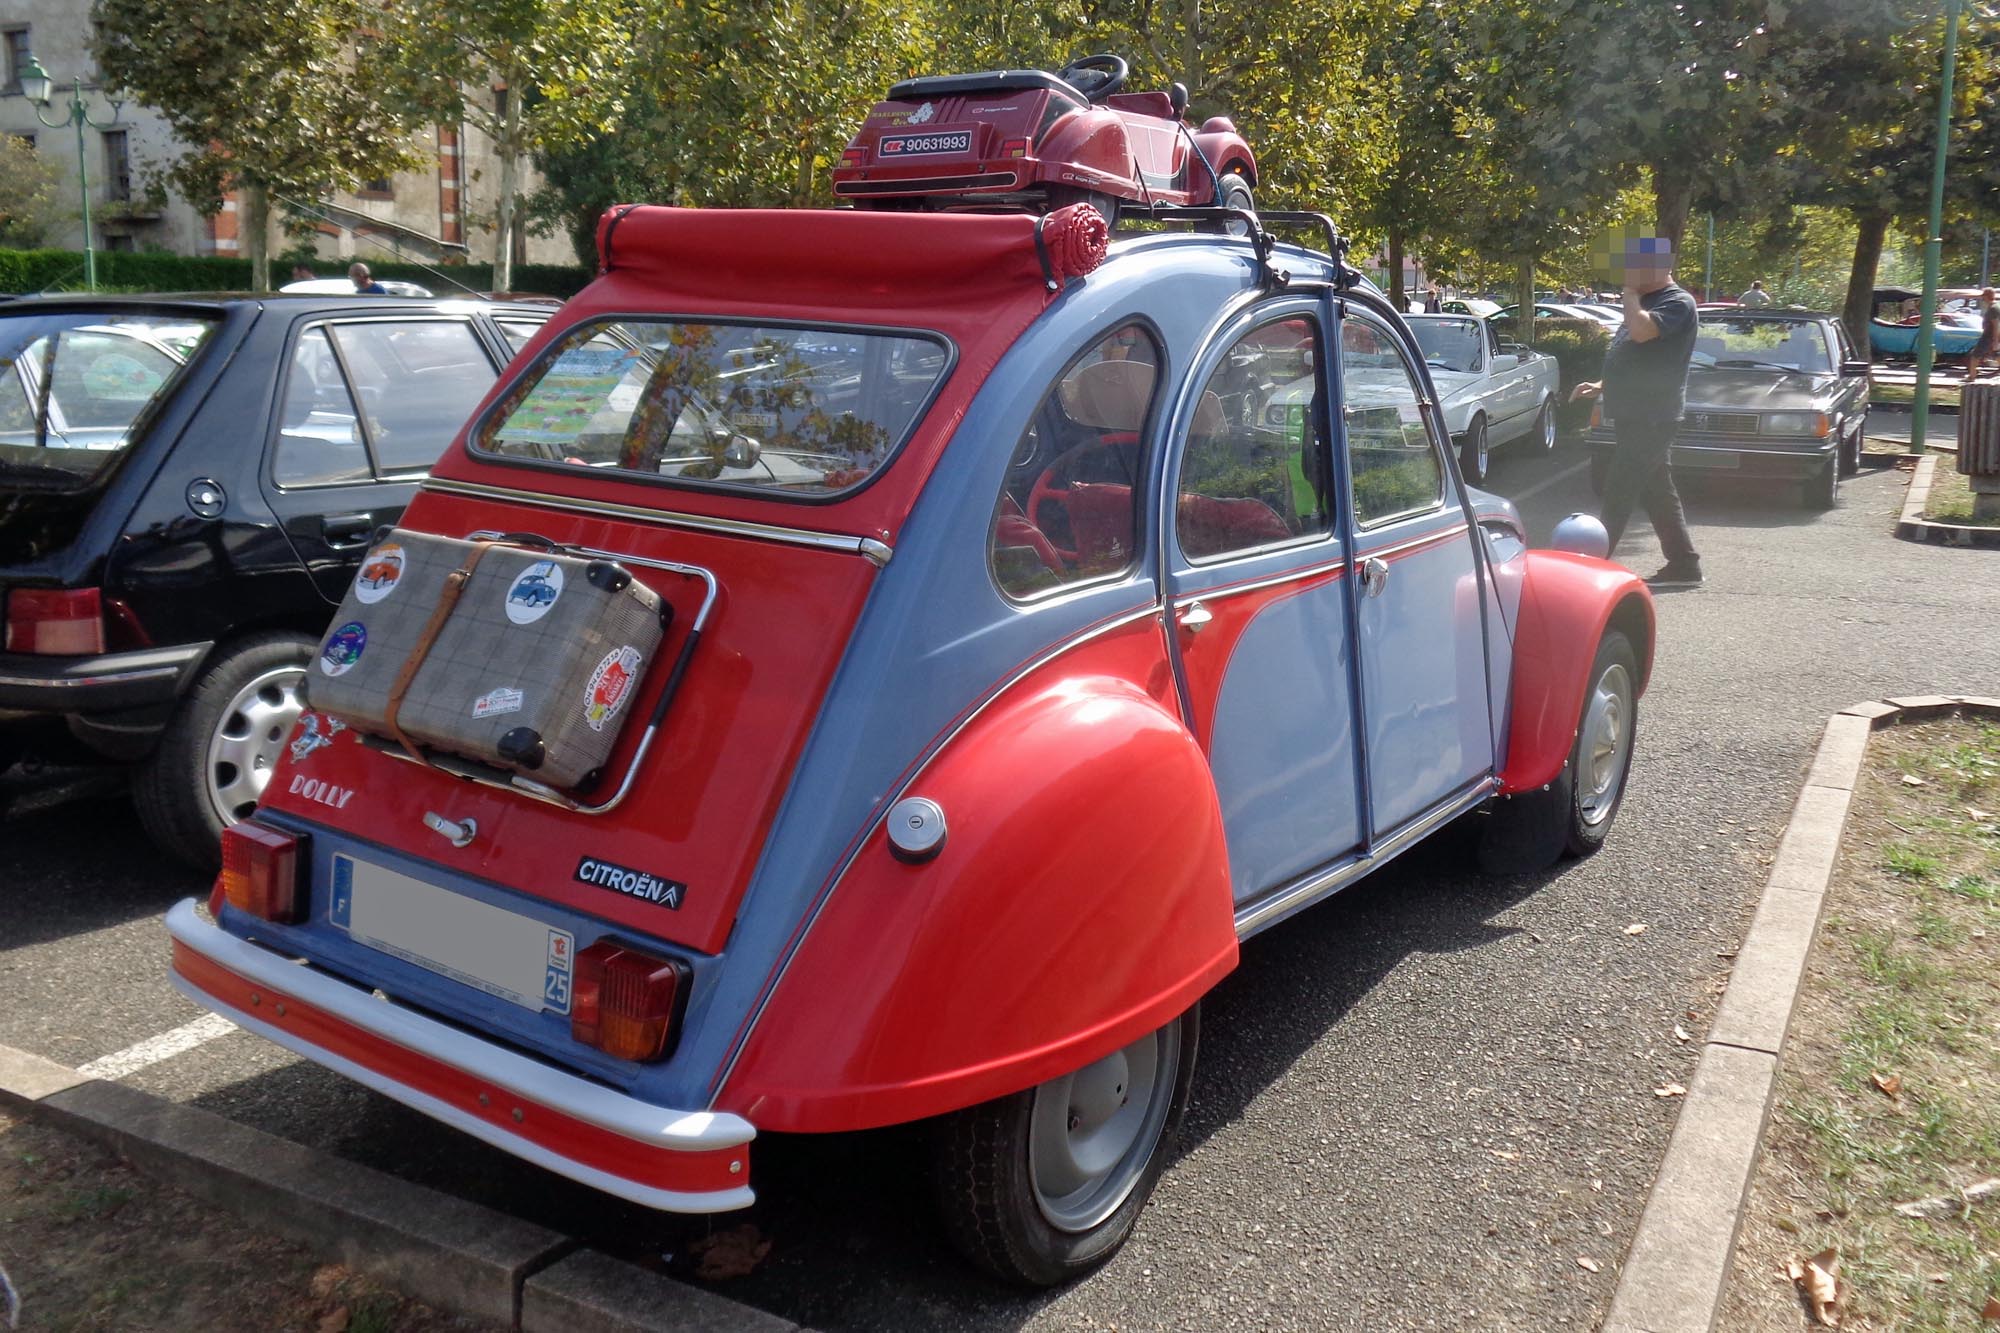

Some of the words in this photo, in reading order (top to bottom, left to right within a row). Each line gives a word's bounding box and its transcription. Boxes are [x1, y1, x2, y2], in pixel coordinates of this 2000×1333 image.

[906, 136, 967, 152] 90631993
[288, 774, 355, 809] DOLLY
[579, 861, 664, 901] CITROËN
[337, 898, 345, 913] F
[546, 970, 568, 1005] 25
